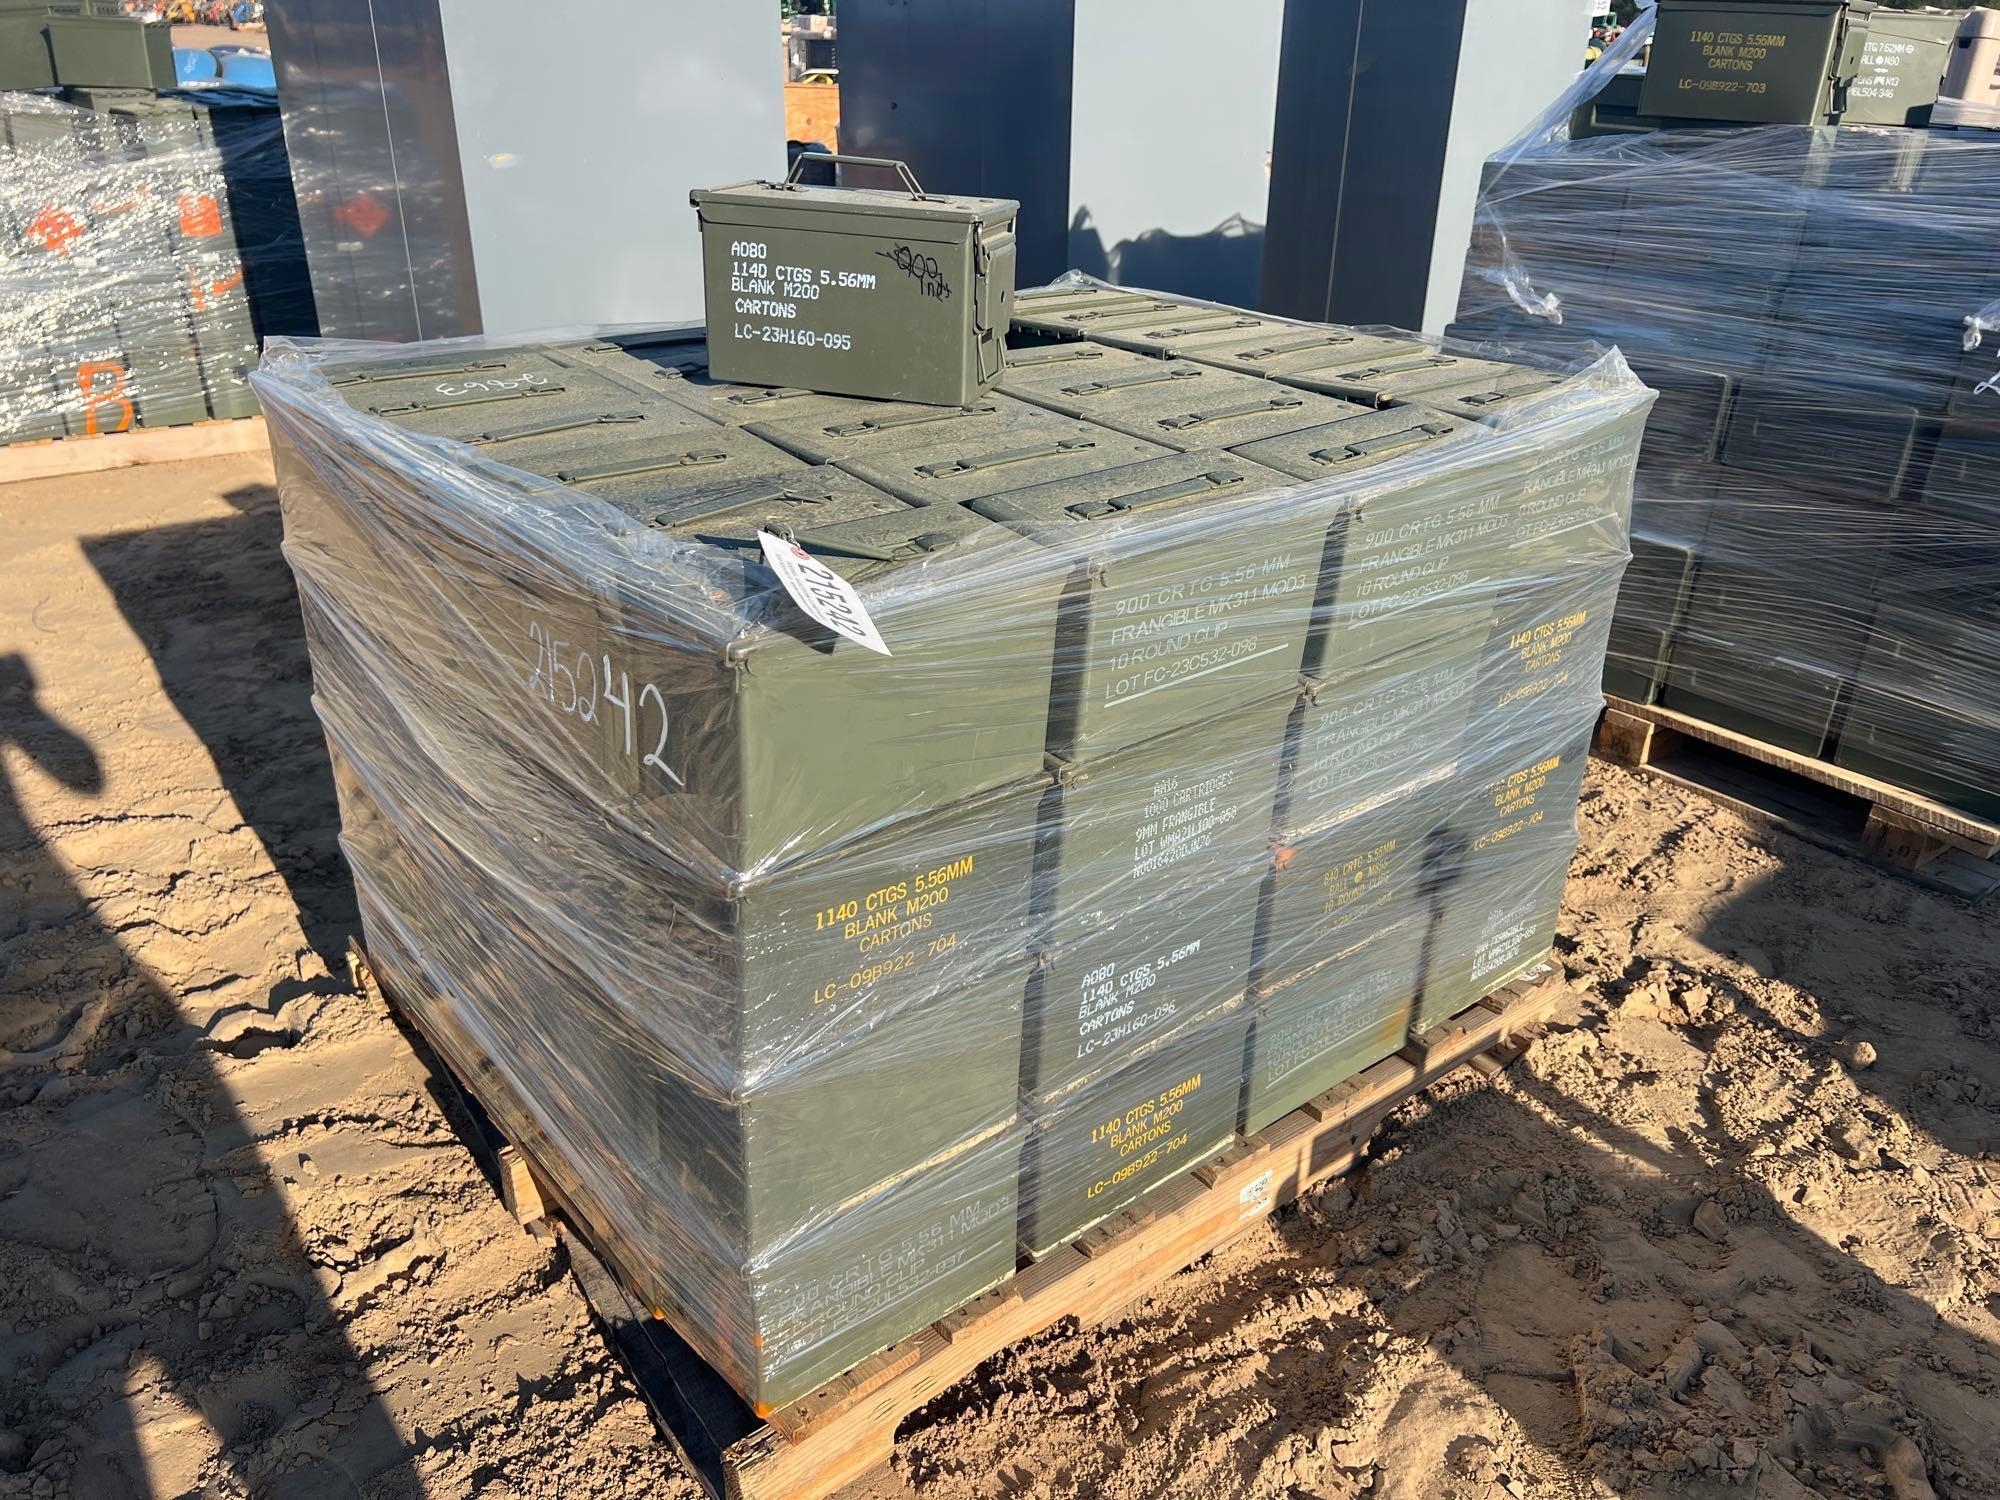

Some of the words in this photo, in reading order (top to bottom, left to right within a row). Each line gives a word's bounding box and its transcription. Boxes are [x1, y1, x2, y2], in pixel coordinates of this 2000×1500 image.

[1690, 31, 1714, 43] 1140
[1717, 32, 1743, 44] CTGS
[1747, 34, 1786, 47] 5.56MM
[1702, 45, 1735, 57] BLANK
[1738, 46, 1767, 59] M200
[1708, 58, 1753, 71] CARTONS
[731, 278, 775, 296] BLANK
[784, 284, 820, 301] M200
[775, 267, 812, 284] CTGS
[820, 271, 876, 290] 5.56MM
[735, 298, 797, 319] CARTONS
[734, 323, 852, 352] LC-23H160-095
[1366, 527, 1395, 550] 900
[1399, 513, 1443, 539] CRTG
[1478, 495, 1501, 514] MM
[1359, 538, 1436, 574] FRANGIBLE
[1435, 527, 1474, 551] MK311
[1114, 593, 1151, 618] 900
[1157, 574, 1215, 606] CRTG
[1219, 562, 1257, 589] 5.56
[1261, 551, 1292, 575] MM
[1372, 565, 1423, 592] ROUND
[1422, 555, 1450, 577] CLIP
[797, 563, 868, 638] 215242
[1111, 605, 1206, 647] FRANGIBLE
[1207, 586, 1258, 618] MK311
[1261, 572, 1307, 601] MOD3
[1350, 601, 1378, 623] LOT
[1129, 632, 1192, 666] ROUND
[1194, 620, 1229, 646] CLIP
[1533, 621, 1556, 641] CTGS
[1520, 641, 1549, 661] BLANK
[1525, 649, 1563, 673] CARTONS
[528, 620, 687, 788] 215242
[1104, 672, 1142, 701] LOT
[1172, 769, 1235, 808] CARTRIDGES
[1507, 769, 1530, 789] CTGS
[1530, 754, 1562, 778] 5.56MM
[1494, 787, 1522, 808] BLANK
[1524, 775, 1547, 795] M200
[1499, 793, 1537, 819] CARTONS
[1134, 821, 1159, 844] 9MM
[1161, 796, 1218, 833] FRANGIBLE
[1133, 839, 1156, 862] LOT
[815, 900, 859, 931] 1140
[865, 881, 908, 912] CTGS
[914, 855, 976, 893] 5.56MM
[844, 904, 899, 940] BLANK
[906, 886, 949, 917] M200
[858, 912, 934, 954] CARTONS
[813, 932, 959, 1005] LC-09B922-704
[1119, 962, 1152, 988] CTGS
[1156, 939, 1202, 971] 5.56MM
[1078, 990, 1120, 1020] BLANK
[1125, 973, 1157, 999] M200
[1079, 999, 1136, 1037] CARTONS
[1090, 1117, 1121, 1145] 1140
[1125, 1099, 1156, 1126] CTGS
[1160, 1073, 1204, 1107] 5.56MM
[1110, 1117, 1149, 1149] BLANK
[1153, 1099, 1185, 1126] M200
[1119, 1120, 1172, 1158] CARTONS
[1087, 1132, 1190, 1200] LC-09B922-704
[948, 1199, 982, 1229] MM
[885, 1258, 926, 1288] CLIP
